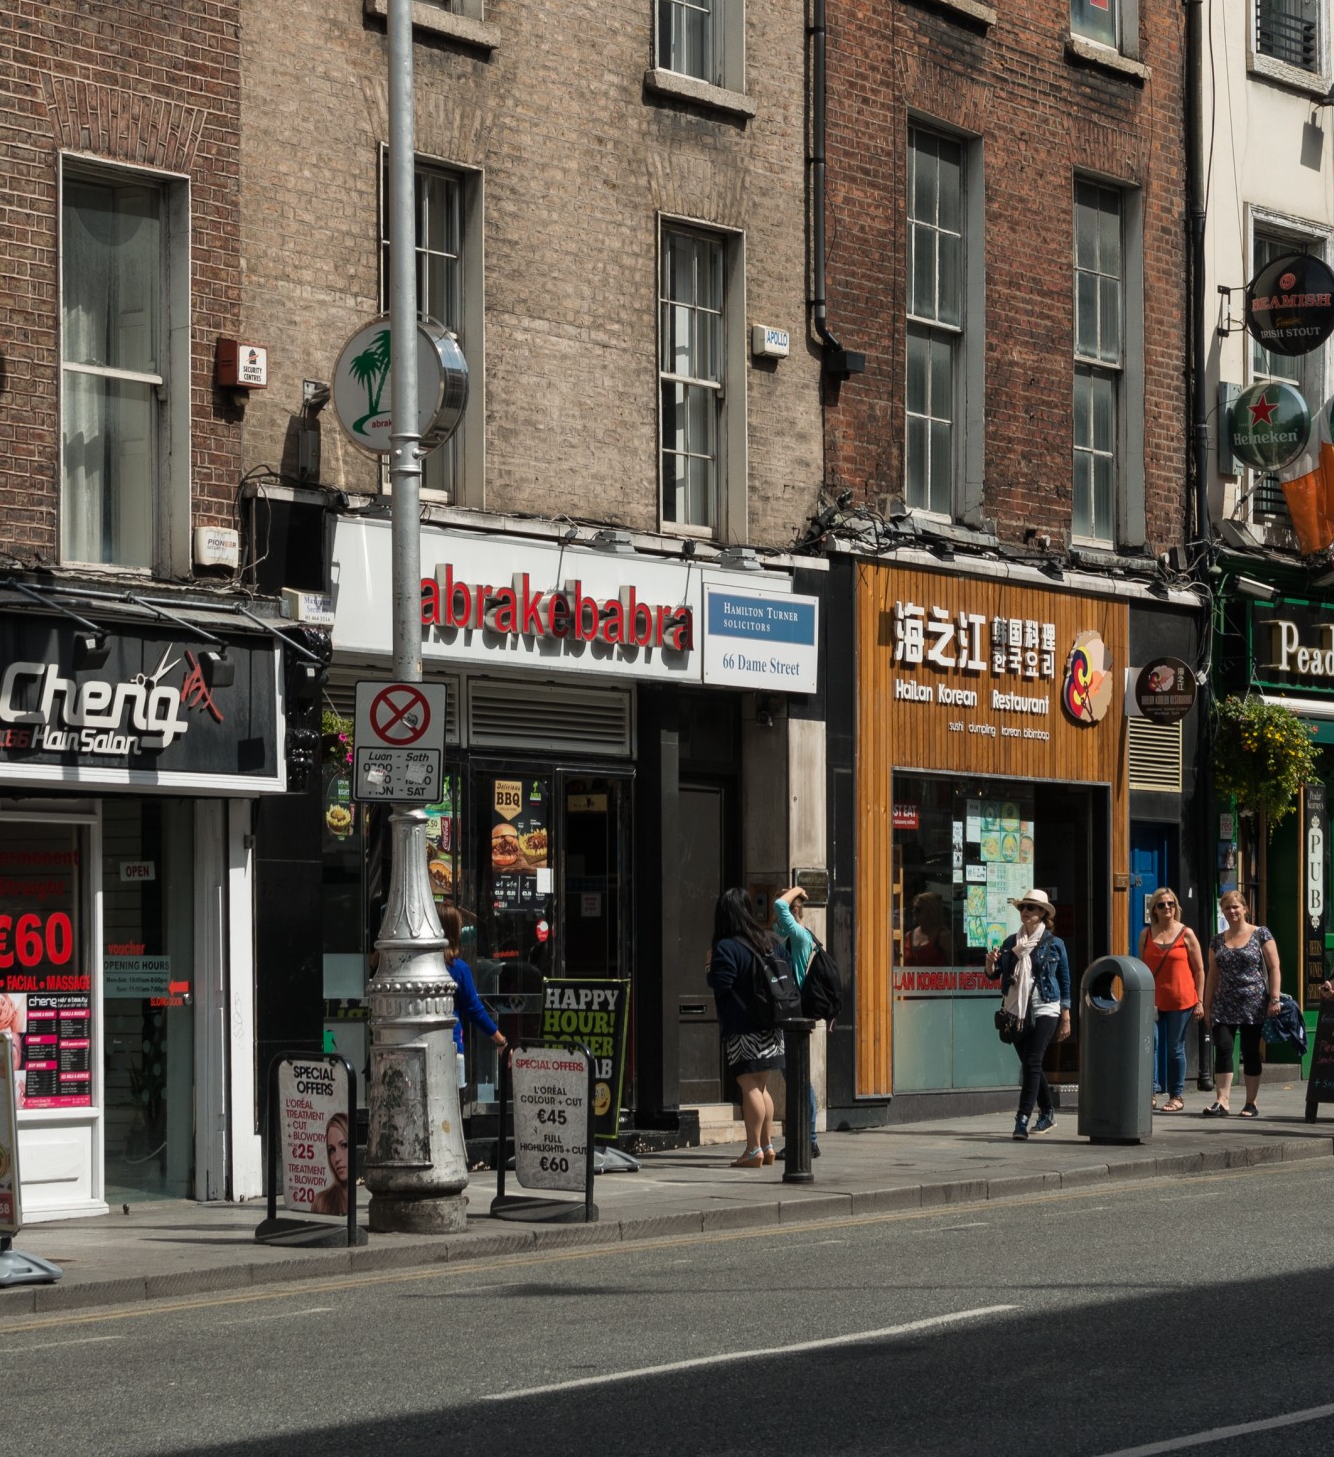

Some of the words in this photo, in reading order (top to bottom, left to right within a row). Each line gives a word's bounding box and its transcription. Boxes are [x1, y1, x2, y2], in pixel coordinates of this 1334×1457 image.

[1252, 293, 1331, 312] BEAMISH
[1261, 329, 1283, 339] IRISH
[1286, 326, 1321, 337] STOUT
[243, 365, 262, 375] SECURITY
[243, 373, 261, 382] CENTRES
[1233, 430, 1298, 446] Heineken
[207, 538, 237, 548] PIONEER
[723, 601, 764, 618] HAMILTON
[766, 606, 799, 623] TURNER
[893, 601, 987, 671] 海之江
[723, 653, 735, 669] 66
[737, 655, 767, 673] Dame
[769, 659, 800, 677] Street
[938, 683, 977, 707] Korean
[993, 689, 1049, 714] Restaurant
[949, 721, 964, 731] sushi
[968, 723, 996, 737] dumpling
[1001, 727, 1021, 737] korean
[1023, 728, 1050, 741] bibimbap
[369, 752, 392, 761] Luan
[405, 753, 429, 762] Sath
[496, 791, 521, 807] BBQ
[125, 866, 150, 877] OPEN
[1310, 835, 1321, 902] PUB
[108, 942, 145, 955] voucher
[104, 961, 139, 970] OPENING
[142, 961, 169, 970] HOURS
[7, 975, 37, 990] FACIAL
[47, 975, 91, 990] MASSAGE
[545, 989, 619, 1011] HAPPY
[543, 1011, 616, 1033] HOUR!
[516, 1059, 550, 1070] SPECIAL
[552, 1059, 584, 1072] OFFERS
[293, 1066, 335, 1081] SPECIAL
[297, 1081, 333, 1097] OFFERS
[534, 1085, 567, 1096] L'ORÉAL
[286, 1099, 313, 1110] L'ORÉAL
[521, 1095, 555, 1105] COLOUR
[565, 1097, 583, 1107] CUT
[286, 1110, 325, 1121] TREATMENT
[537, 1109, 567, 1125] €45
[293, 1121, 307, 1130] CUT
[544, 1134, 562, 1143] FULL
[292, 1144, 314, 1160] €25
[520, 1143, 564, 1154] HIGHLIGHTS
[572, 1145, 588, 1155] CUT
[289, 1164, 325, 1175] TREATMENT
[539, 1157, 569, 1173] €60
[293, 1188, 315, 1203] €20
